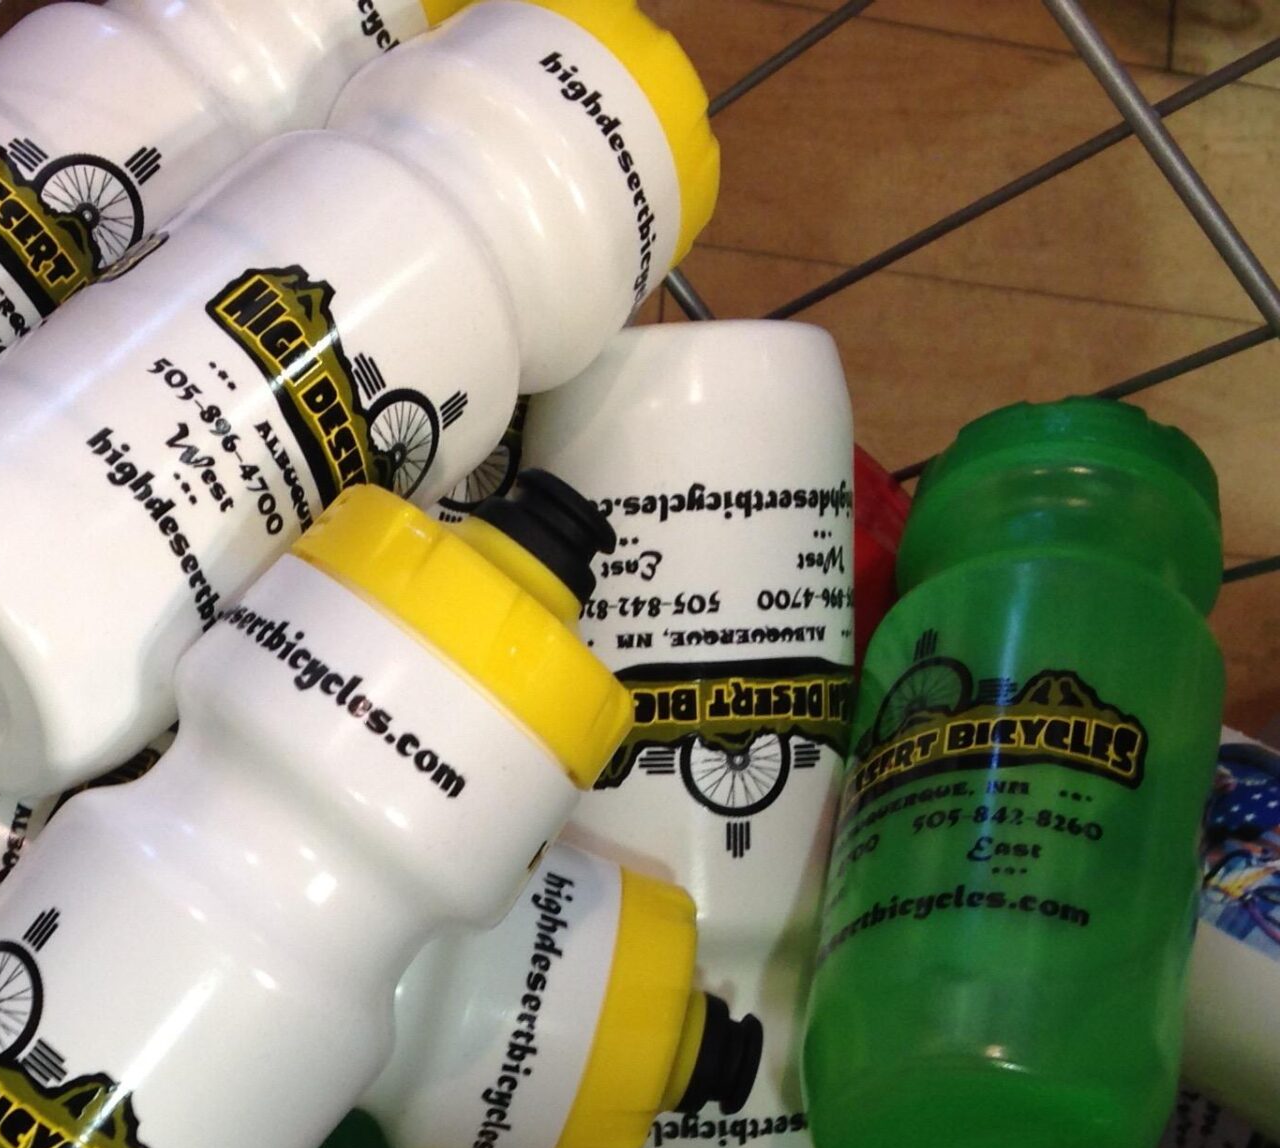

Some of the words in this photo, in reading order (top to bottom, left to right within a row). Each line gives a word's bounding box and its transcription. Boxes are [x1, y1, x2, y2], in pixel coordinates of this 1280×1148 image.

[214, 273, 323, 387] HIGH
[146, 357, 284, 537] 505-896-4700
[165, 421, 235, 514] West
[86, 426, 221, 633] highdesertbi
[601, 549, 664, 582] East
[796, 545, 845, 575] West
[633, 686, 702, 725] BIC
[707, 679, 824, 723] DESERT
[943, 715, 1146, 778] BICYCLES
[910, 804, 1104, 842] 505-842-8260
[966, 836, 1043, 863] East
